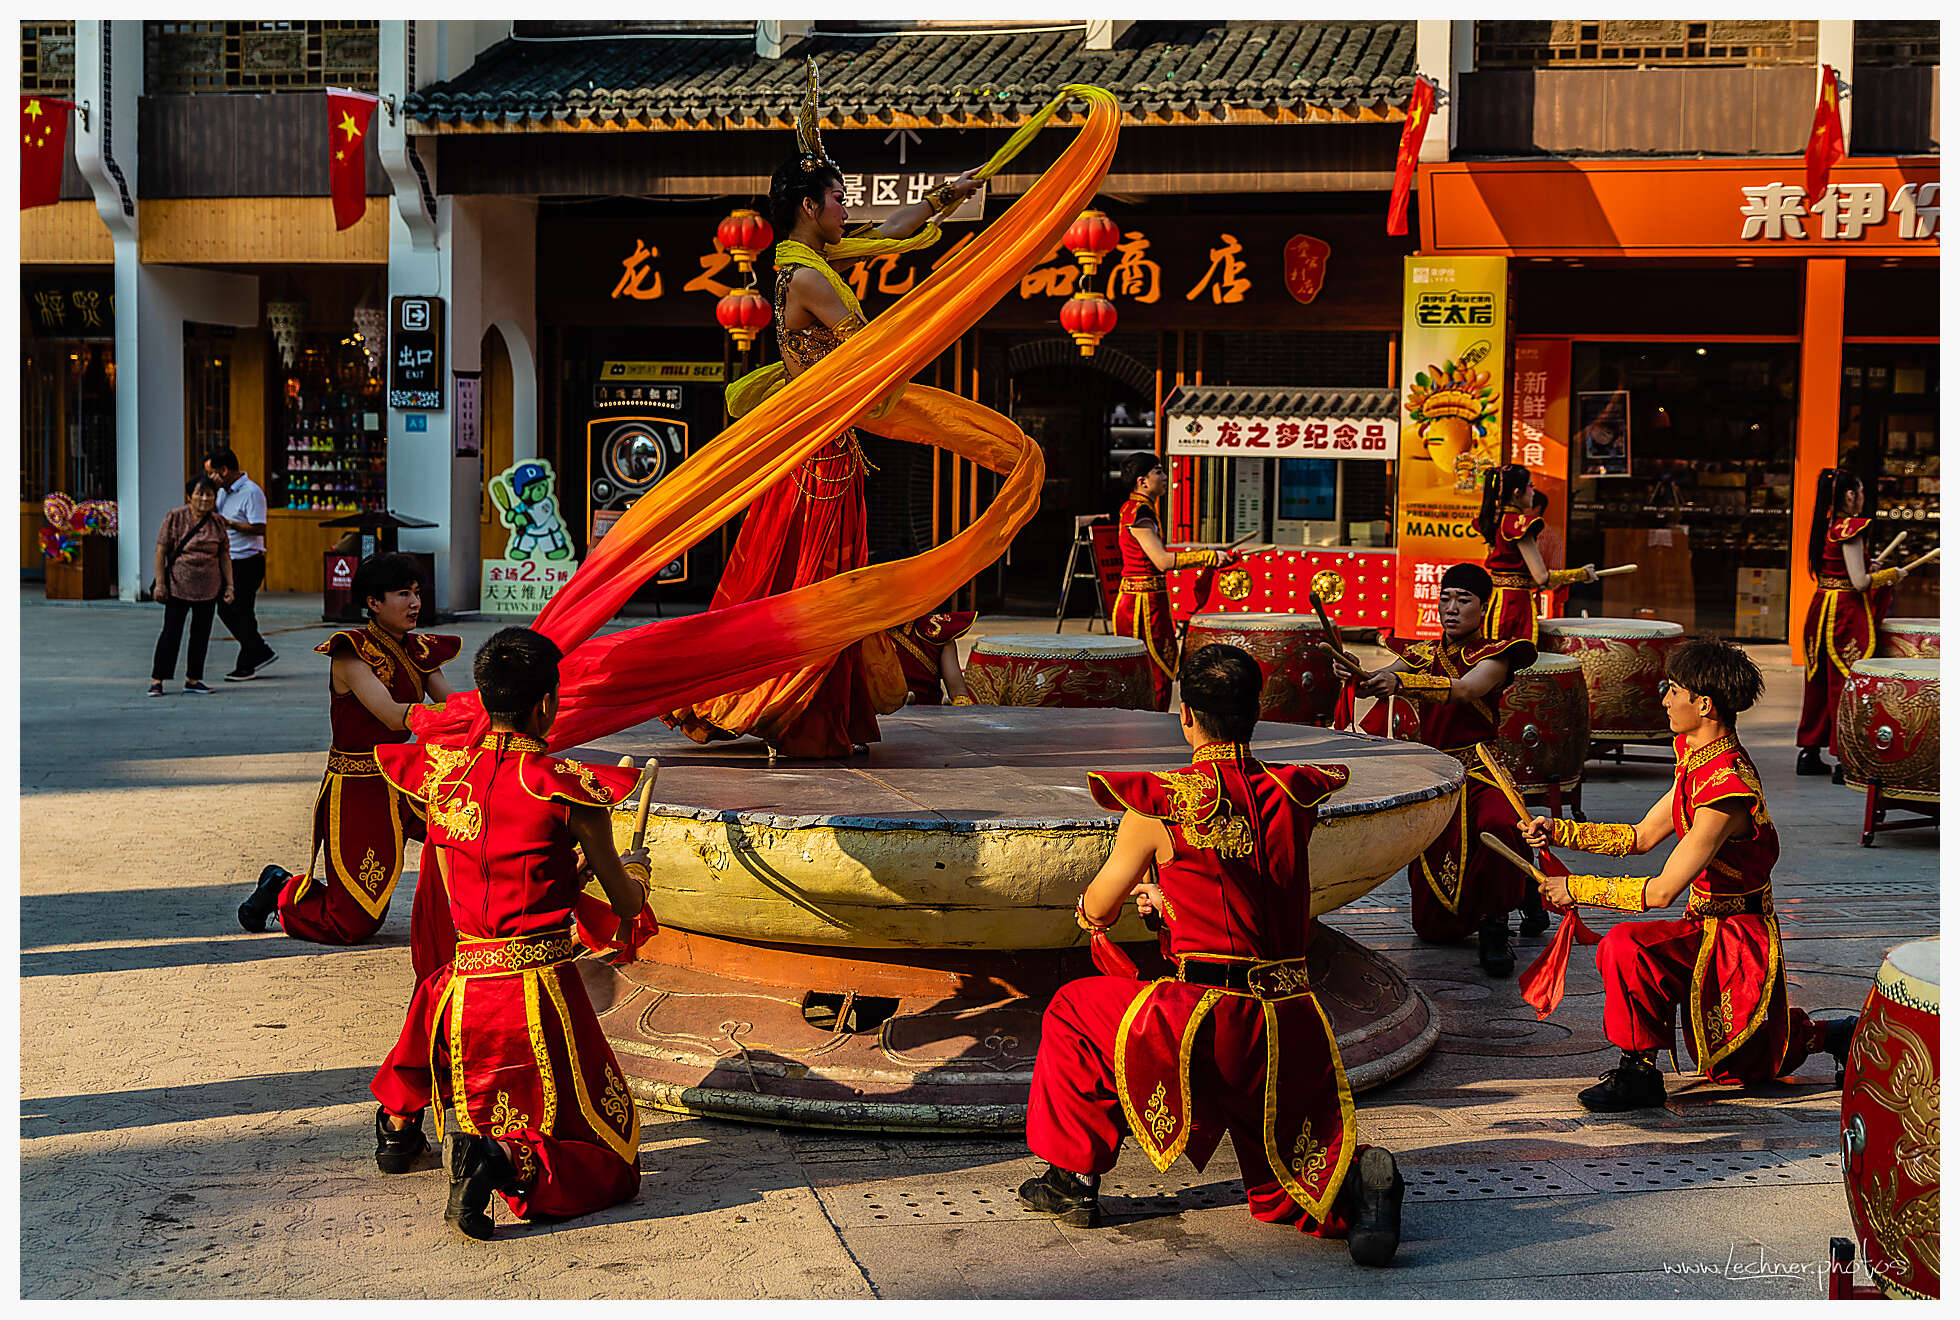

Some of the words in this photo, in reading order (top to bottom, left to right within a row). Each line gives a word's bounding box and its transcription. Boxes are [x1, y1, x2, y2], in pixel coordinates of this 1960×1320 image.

[1419, 304, 1492, 324] 芒太后
[399, 345, 432, 367] 出口
[1522, 371, 1547, 466] 新鲜零食
[1215, 421, 1387, 451] 龙之梦纪念品
[1406, 510, 1448, 518] PREMIUM
[484, 585, 565, 600] 天天维尼
